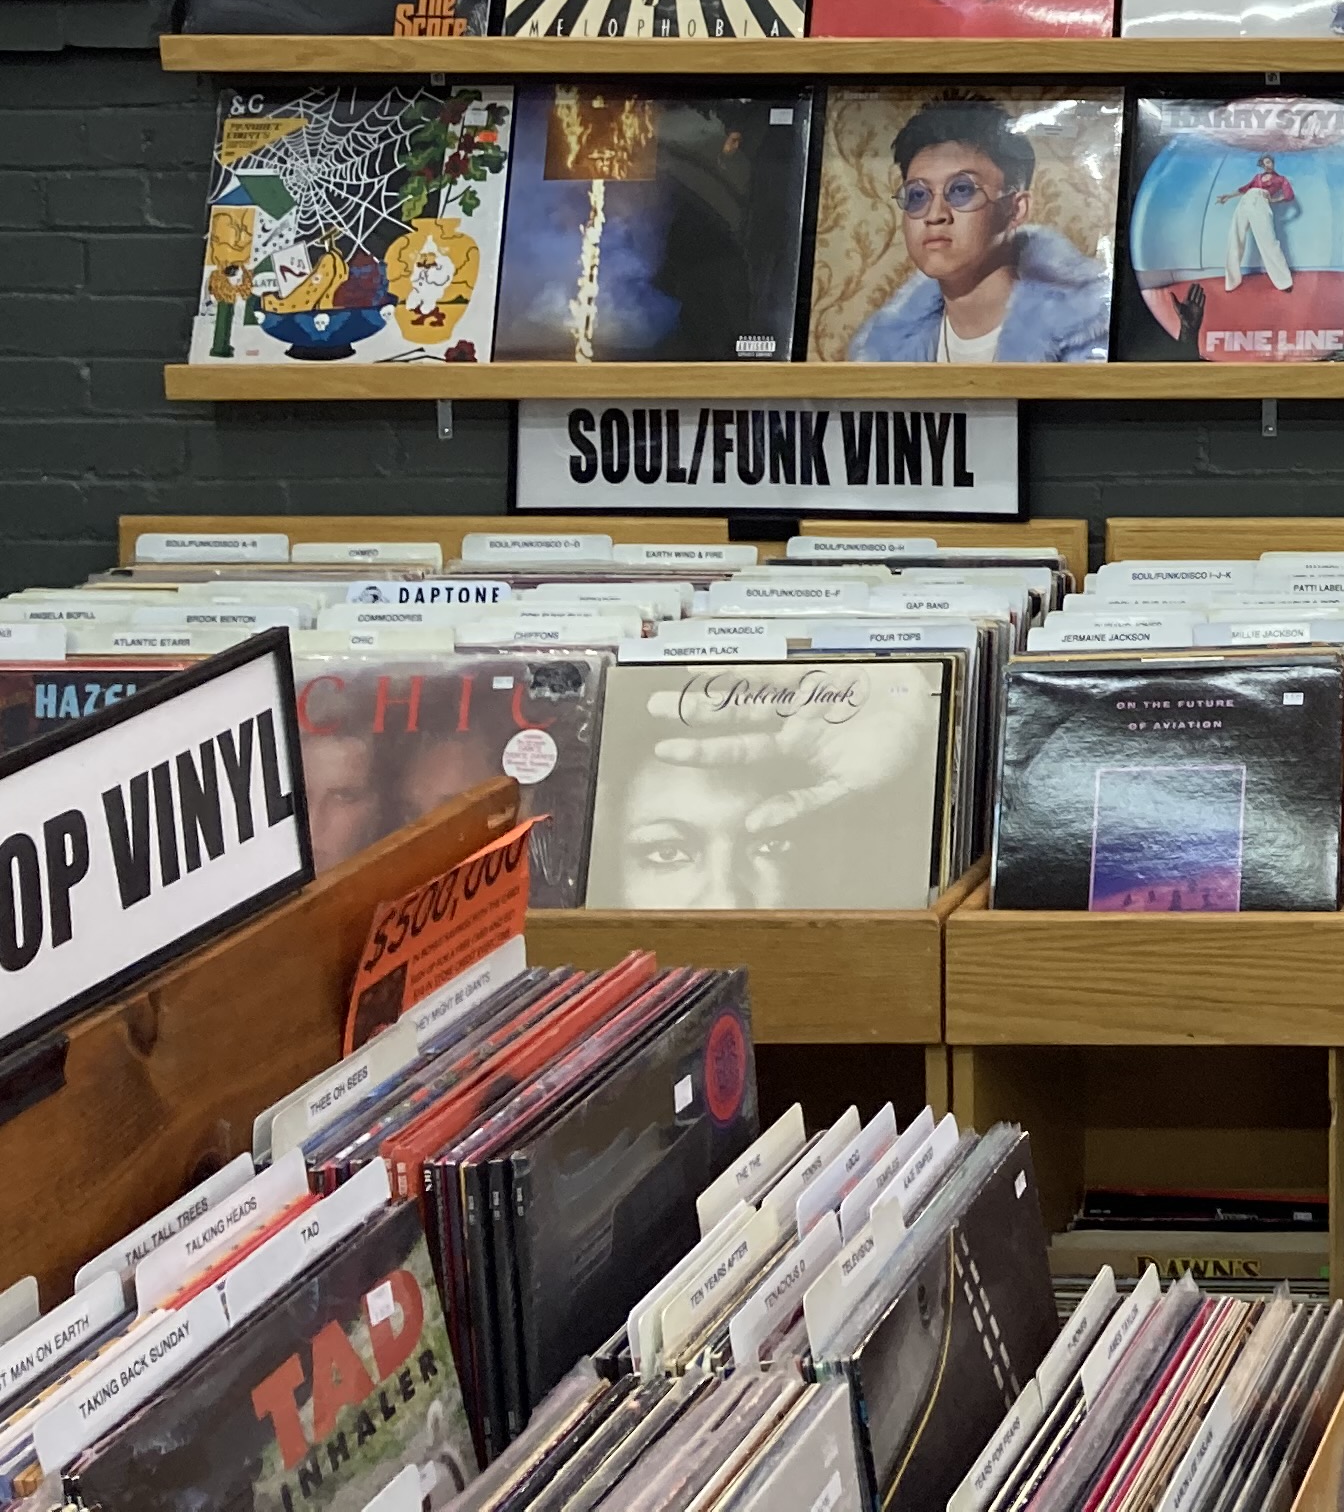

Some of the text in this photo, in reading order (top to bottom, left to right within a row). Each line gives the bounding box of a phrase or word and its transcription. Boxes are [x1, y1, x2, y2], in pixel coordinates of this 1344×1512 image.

[1207, 330, 1343, 351] FINE LINE
[568, 408, 974, 487] SOUL/FUNK VINYL
[399, 587, 499, 603] DAPTONE
[926, 602, 949, 610] BAND
[1294, 584, 1317, 592] PATTI
[664, 646, 739, 656] ROBERTA FLACK
[870, 633, 921, 643] FOUR TOPS
[35, 683, 138, 719] HAZE
[300, 673, 556, 733] CHIC
[706, 668, 858, 724] Roberta Flack
[1116, 699, 1234, 710] ON THE FUTURE
[1129, 719, 1222, 731] OF AVIATION
[101, 708, 294, 909] VINYL
[125, 1195, 209, 1267] TALL TALL TREES
[185, 1196, 258, 1256] TALKING HEADS
[301, 1221, 320, 1245] TAD
[78, 1320, 192, 1420] TAKING BACK SUNDAY
[251, 1267, 424, 1470] TAD
[279, 1348, 439, 1512] INHALER
